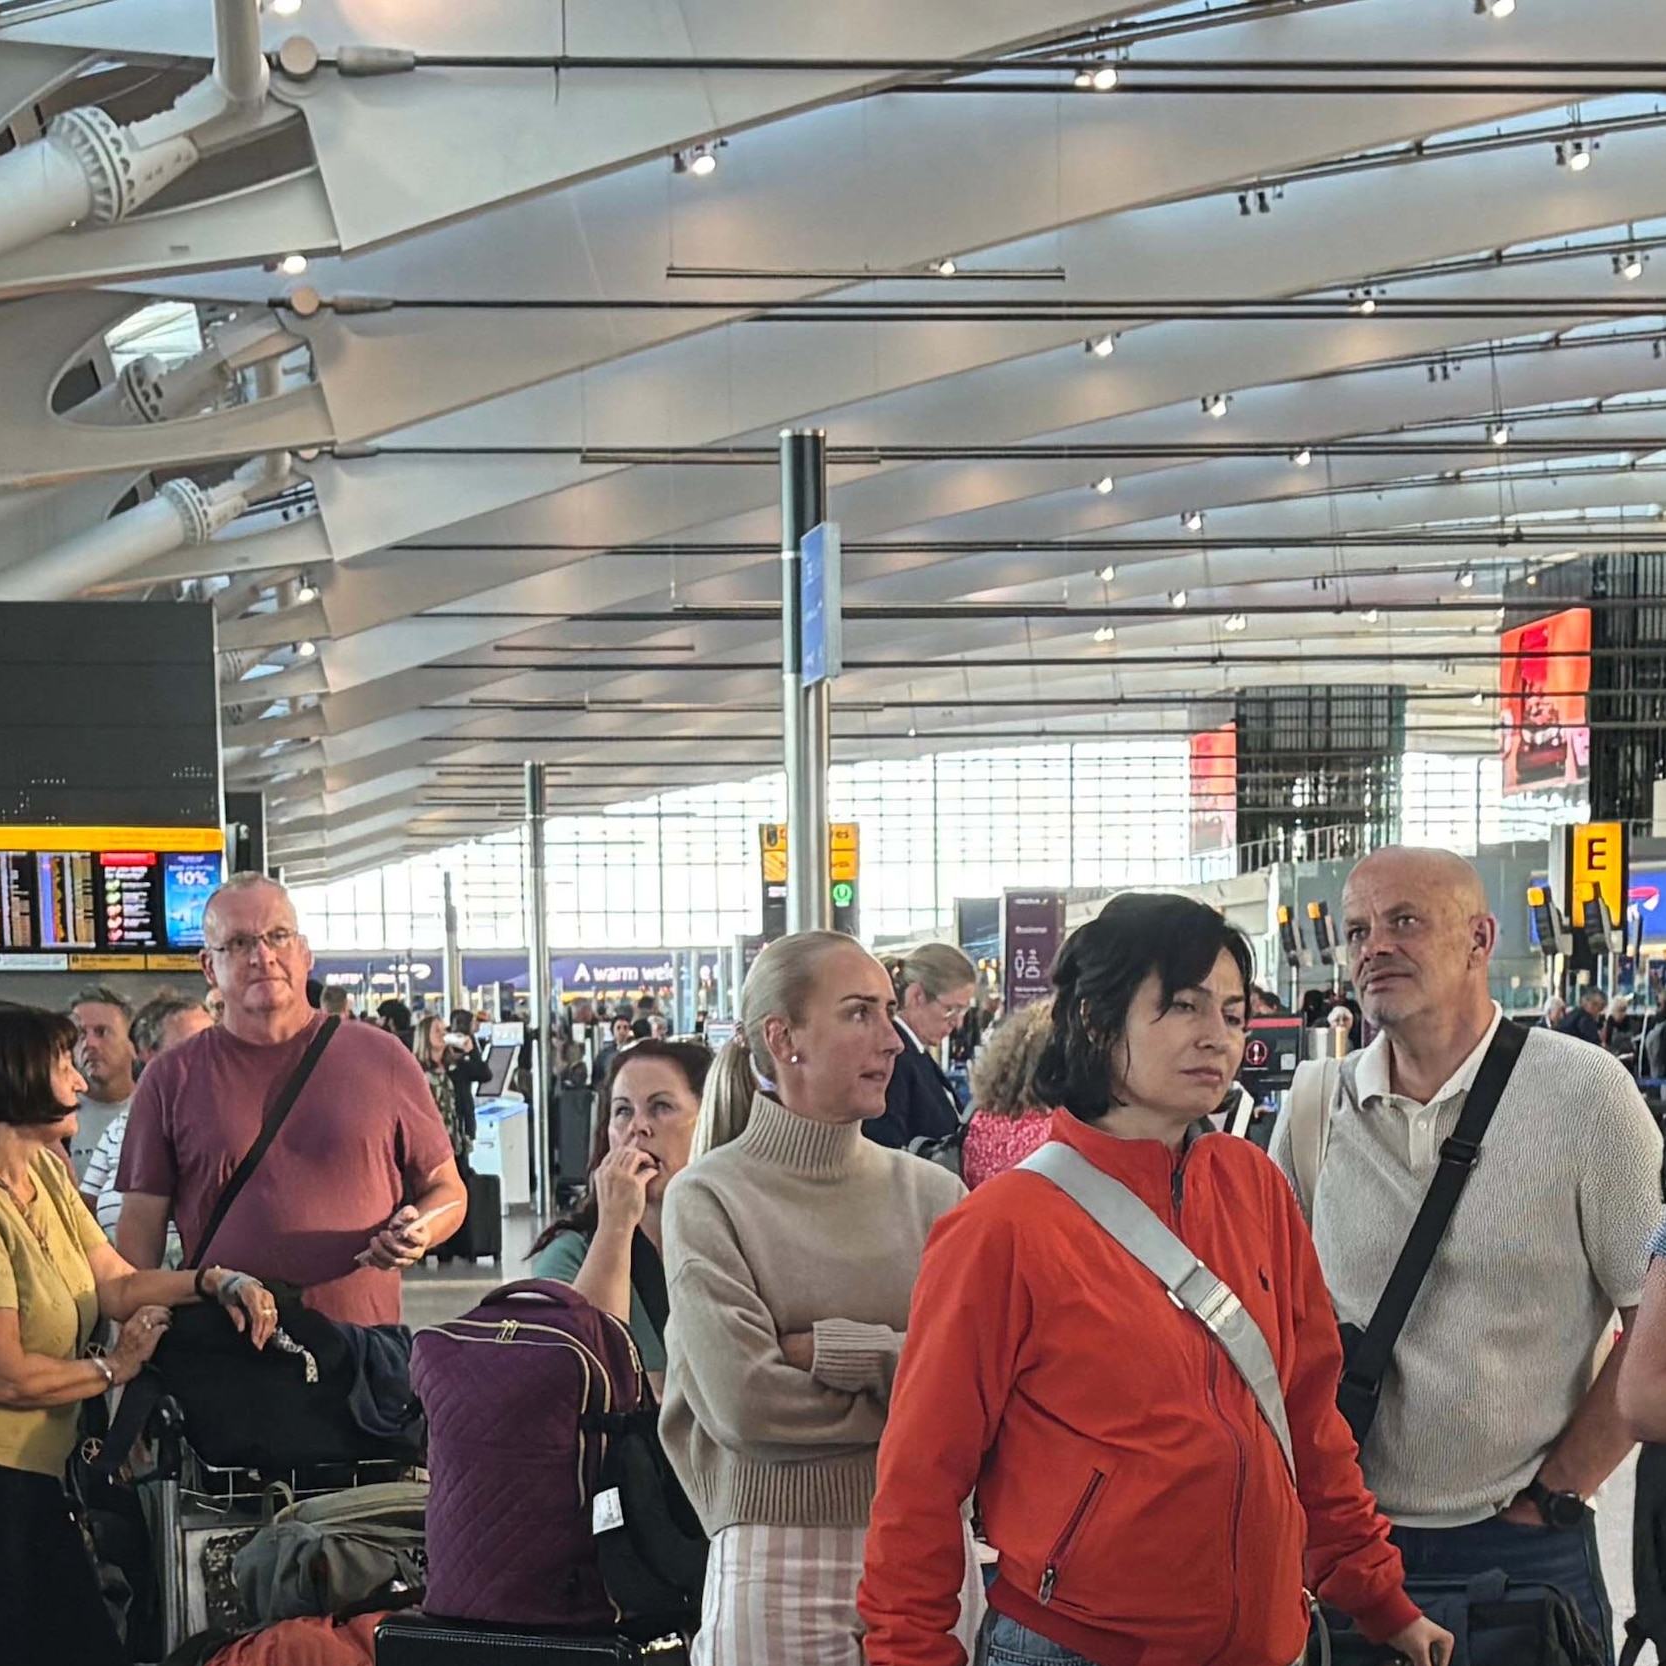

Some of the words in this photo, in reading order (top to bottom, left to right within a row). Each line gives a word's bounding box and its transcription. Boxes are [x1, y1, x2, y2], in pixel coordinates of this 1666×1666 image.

[1587, 837, 1607, 870] E
[176, 871, 209, 886] 10%
[574, 963, 591, 982] A
[593, 967, 638, 981] warm
